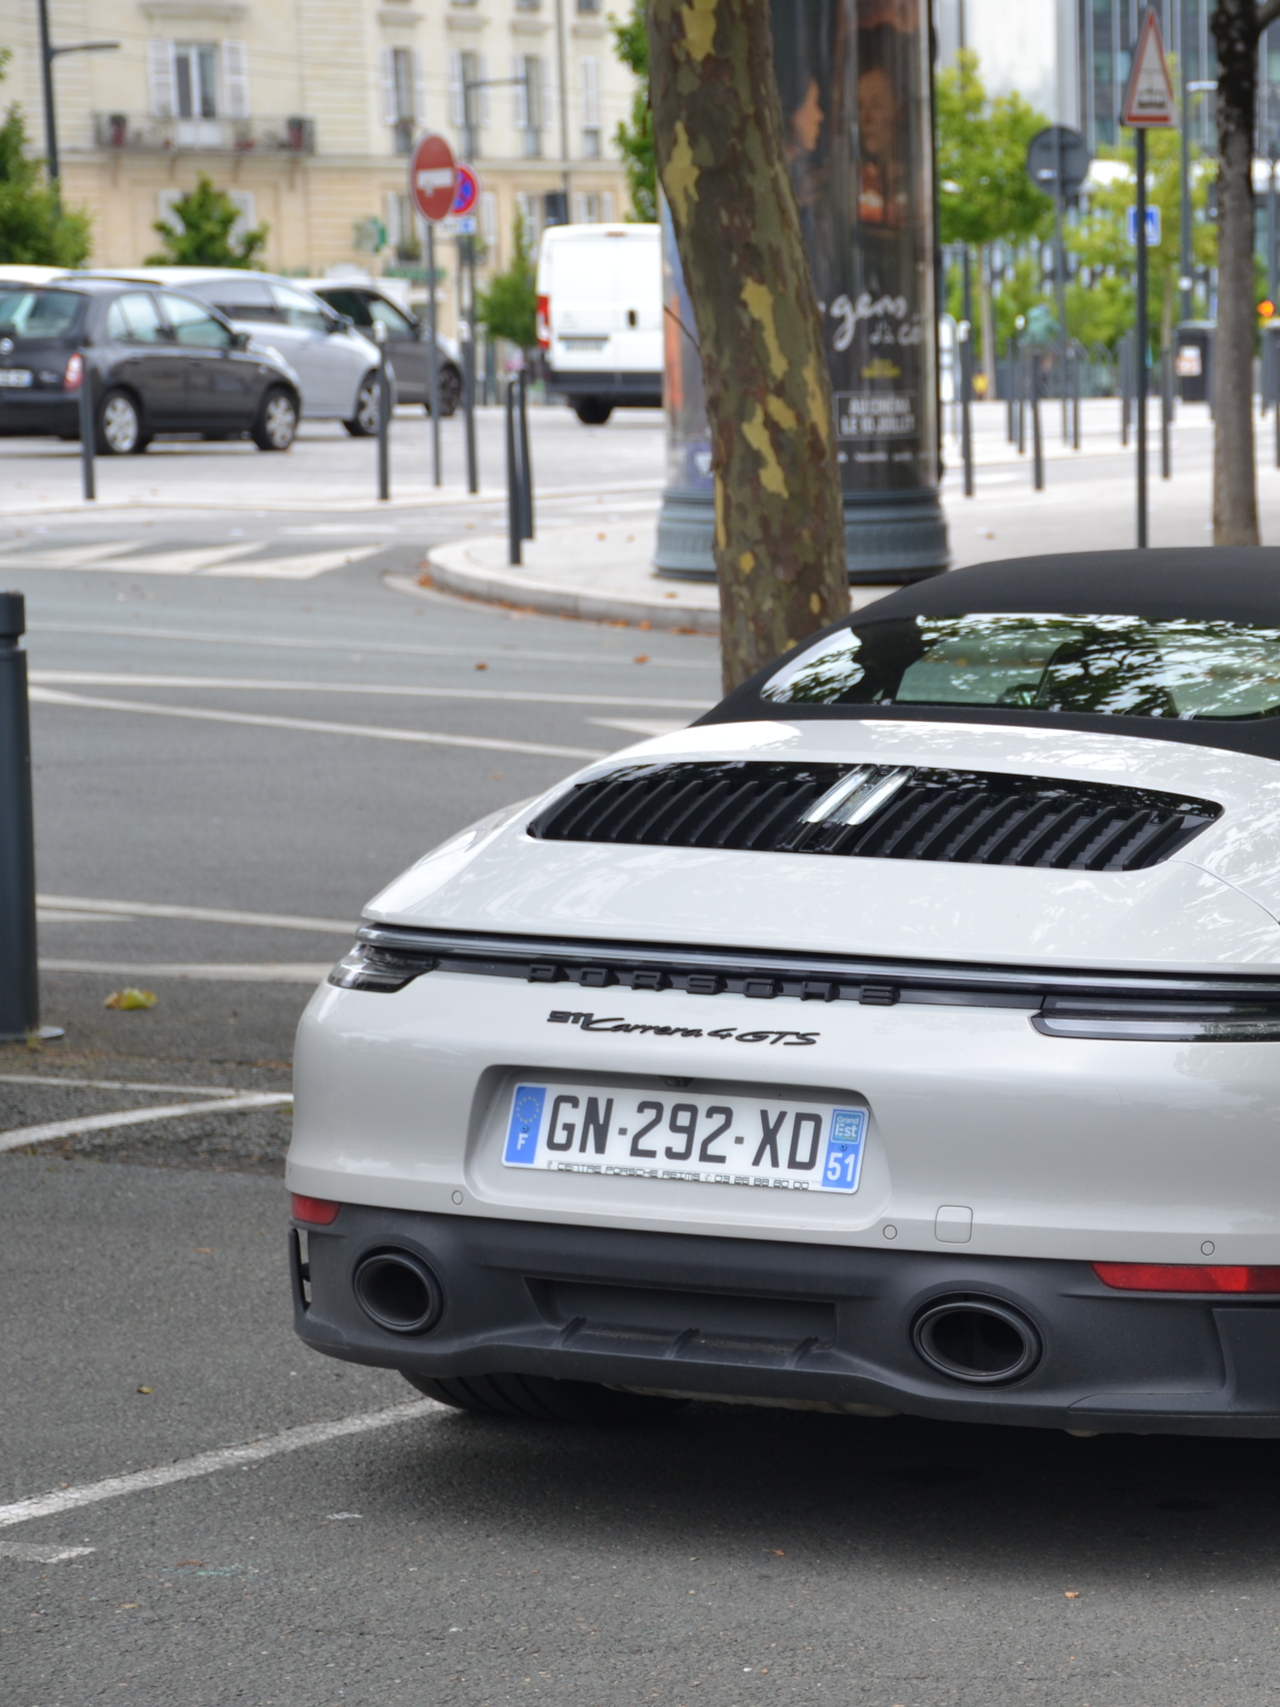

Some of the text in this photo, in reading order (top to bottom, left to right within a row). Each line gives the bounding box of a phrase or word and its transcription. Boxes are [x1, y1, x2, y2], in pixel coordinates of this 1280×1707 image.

[527, 964, 898, 1006] PORSCHE
[547, 1010, 821, 1046] 911 Carrera 4 GTS
[546, 1094, 823, 1171] GN-292-XD
[834, 1123, 858, 1138] Est
[836, 1115, 860, 1125] Grand
[516, 1133, 529, 1151] F
[558, 1162, 601, 1175] CENTRE
[605, 1166, 659, 1180] PORSCHE
[662, 1170, 700, 1182] REIMS
[826, 1151, 856, 1183] 51
